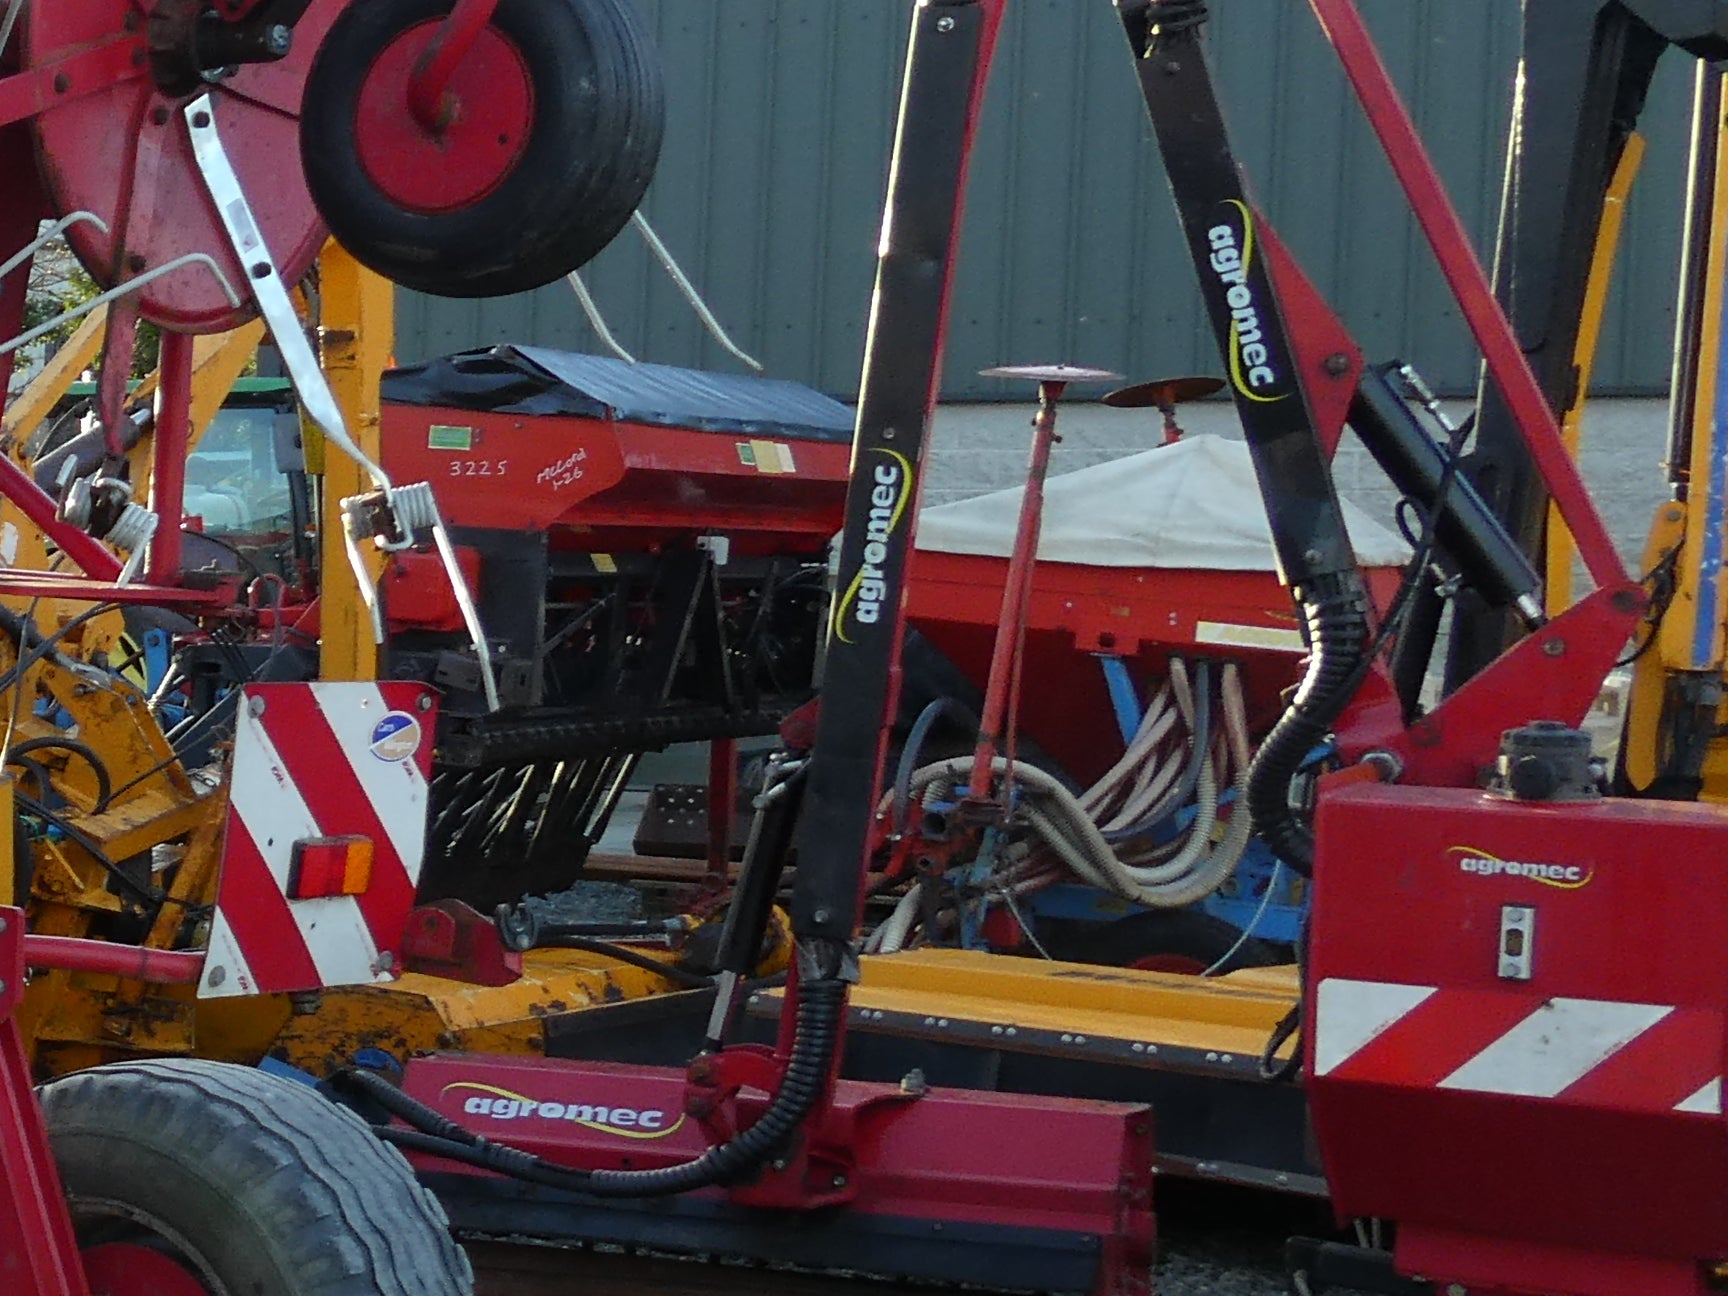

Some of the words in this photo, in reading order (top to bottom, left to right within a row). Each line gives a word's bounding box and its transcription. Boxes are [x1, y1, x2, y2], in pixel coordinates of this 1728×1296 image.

[1208, 224, 1274, 387] agromec
[450, 460, 507, 476] 3225
[856, 465, 898, 624] agromec
[1460, 857, 1581, 880] agromec
[464, 1097, 663, 1128] agromec
